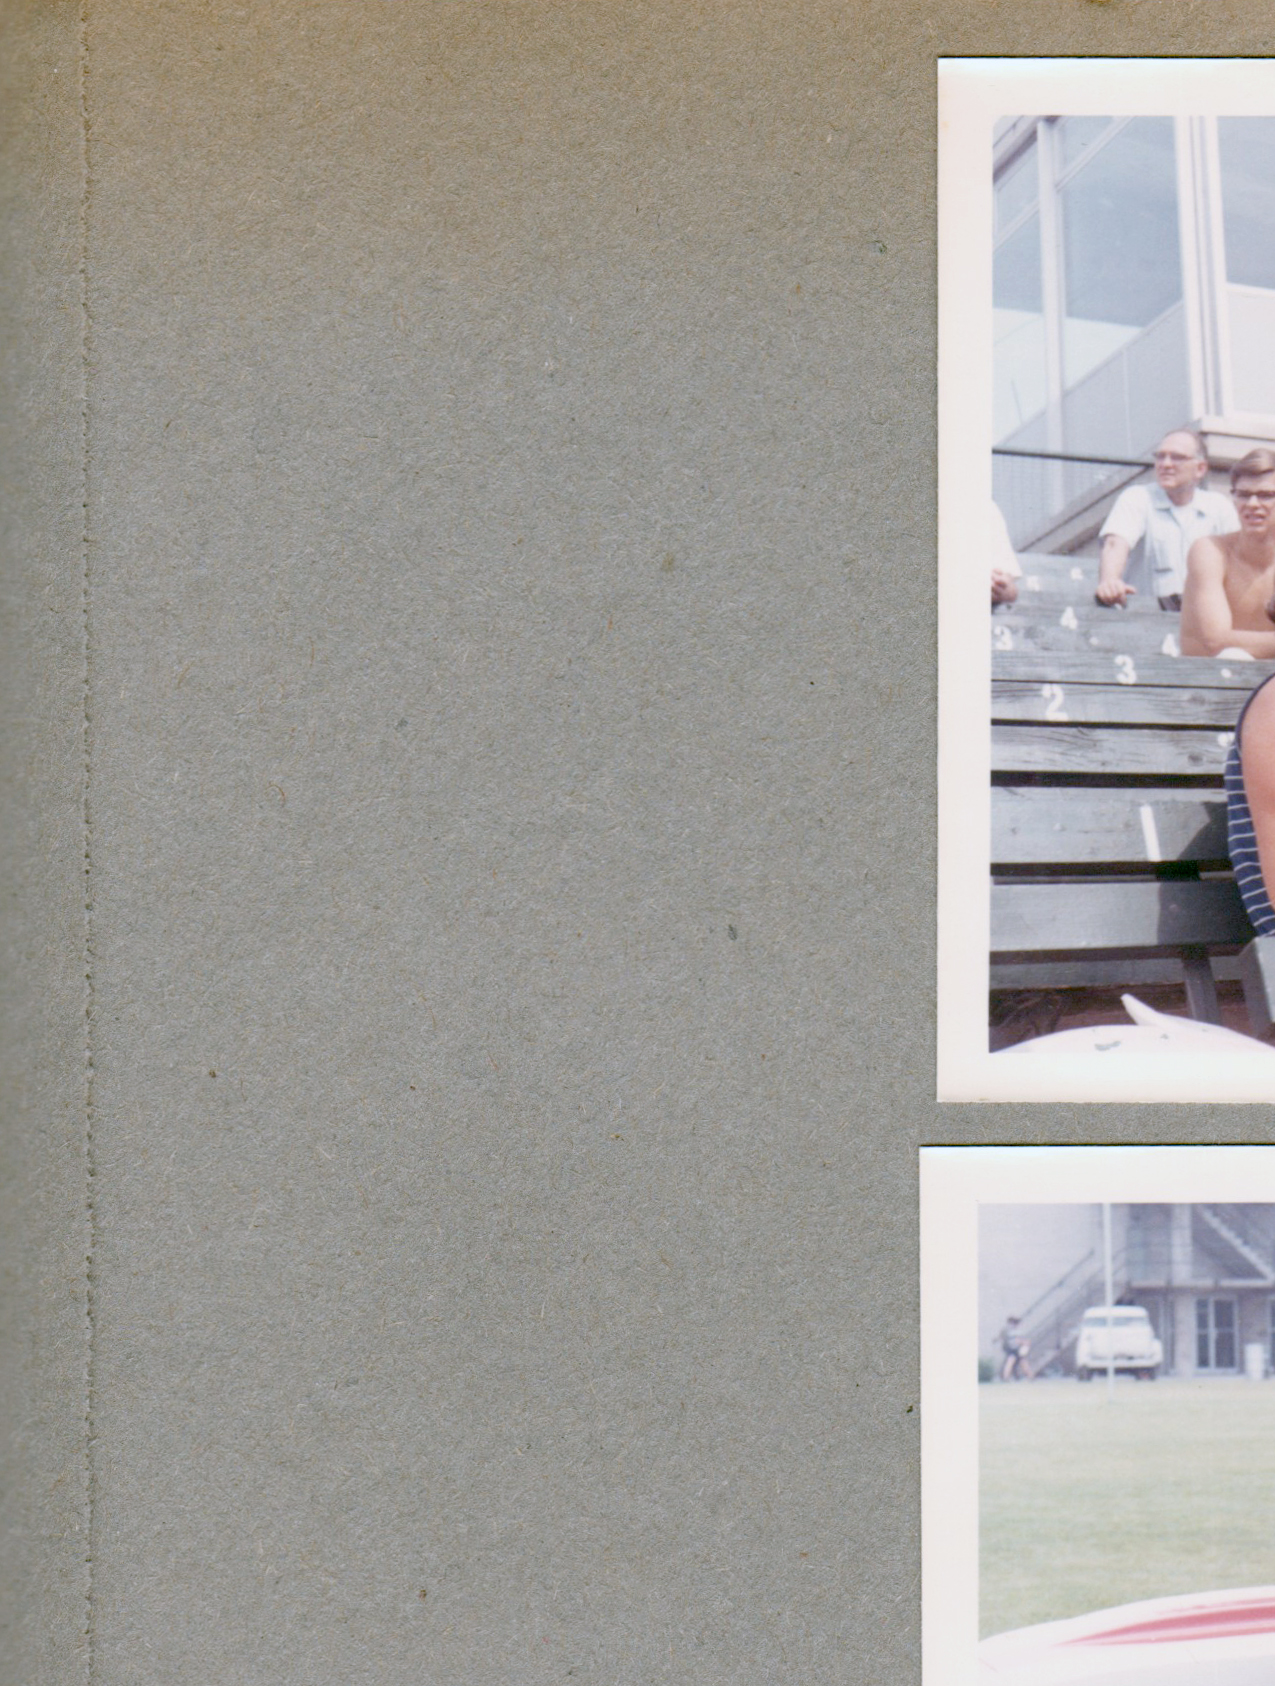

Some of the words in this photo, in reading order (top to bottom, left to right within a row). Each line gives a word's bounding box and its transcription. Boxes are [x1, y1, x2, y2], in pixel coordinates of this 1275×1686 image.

[1060, 606, 1078, 630] 4
[1114, 654, 1137, 685] 3
[1041, 683, 1069, 722] 2
[1140, 804, 1161, 861] 1
